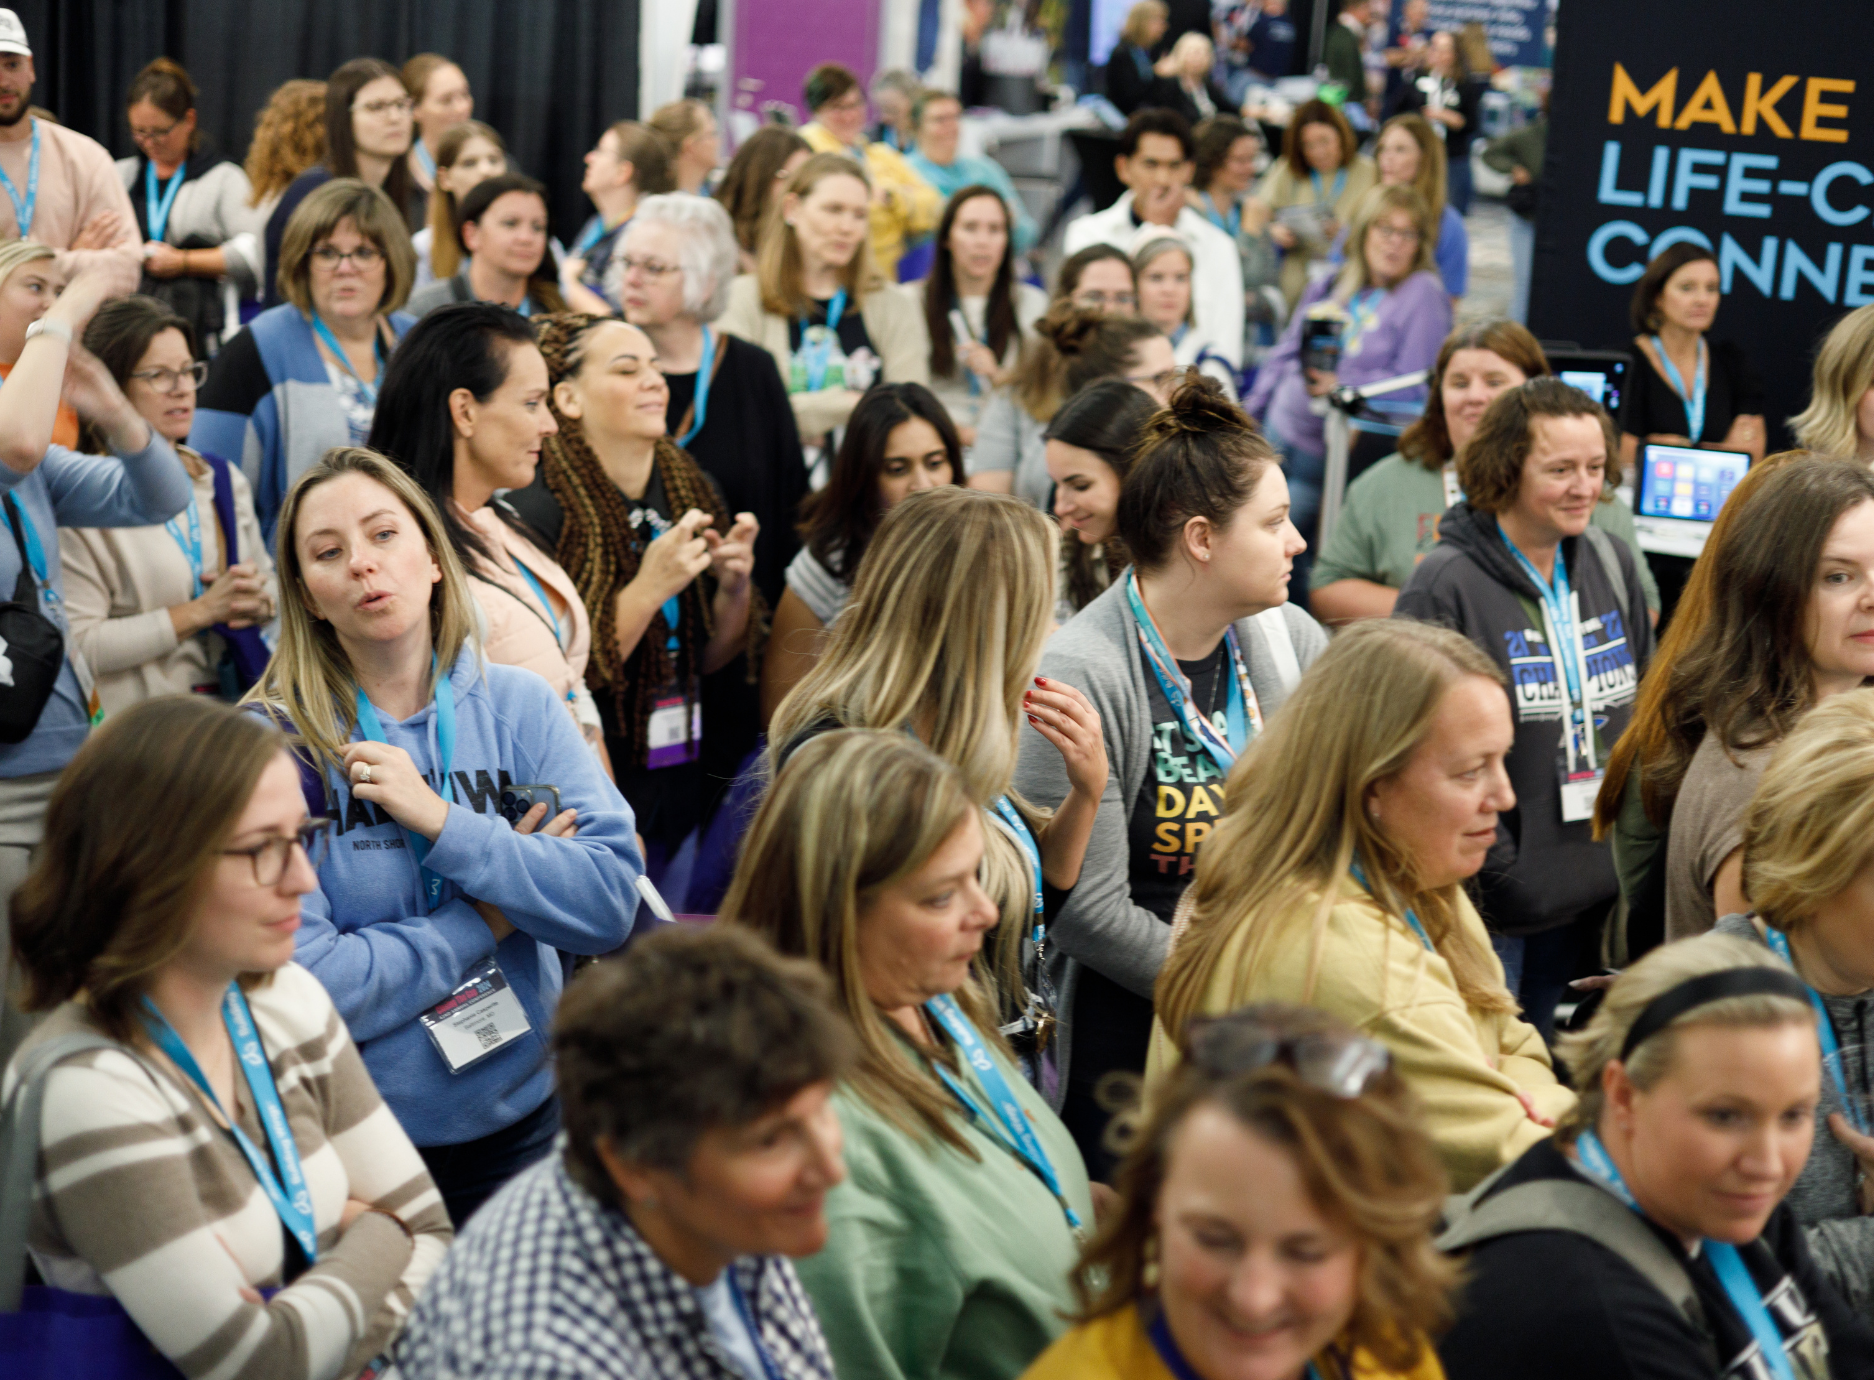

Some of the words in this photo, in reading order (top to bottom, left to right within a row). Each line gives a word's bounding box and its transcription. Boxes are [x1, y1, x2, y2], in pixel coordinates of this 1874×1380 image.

[1608, 61, 1857, 144] MAKE
[1597, 140, 1874, 228] LIFE-C
[1150, 721, 1203, 753] T'S
[352, 839, 382, 851] NORTH
